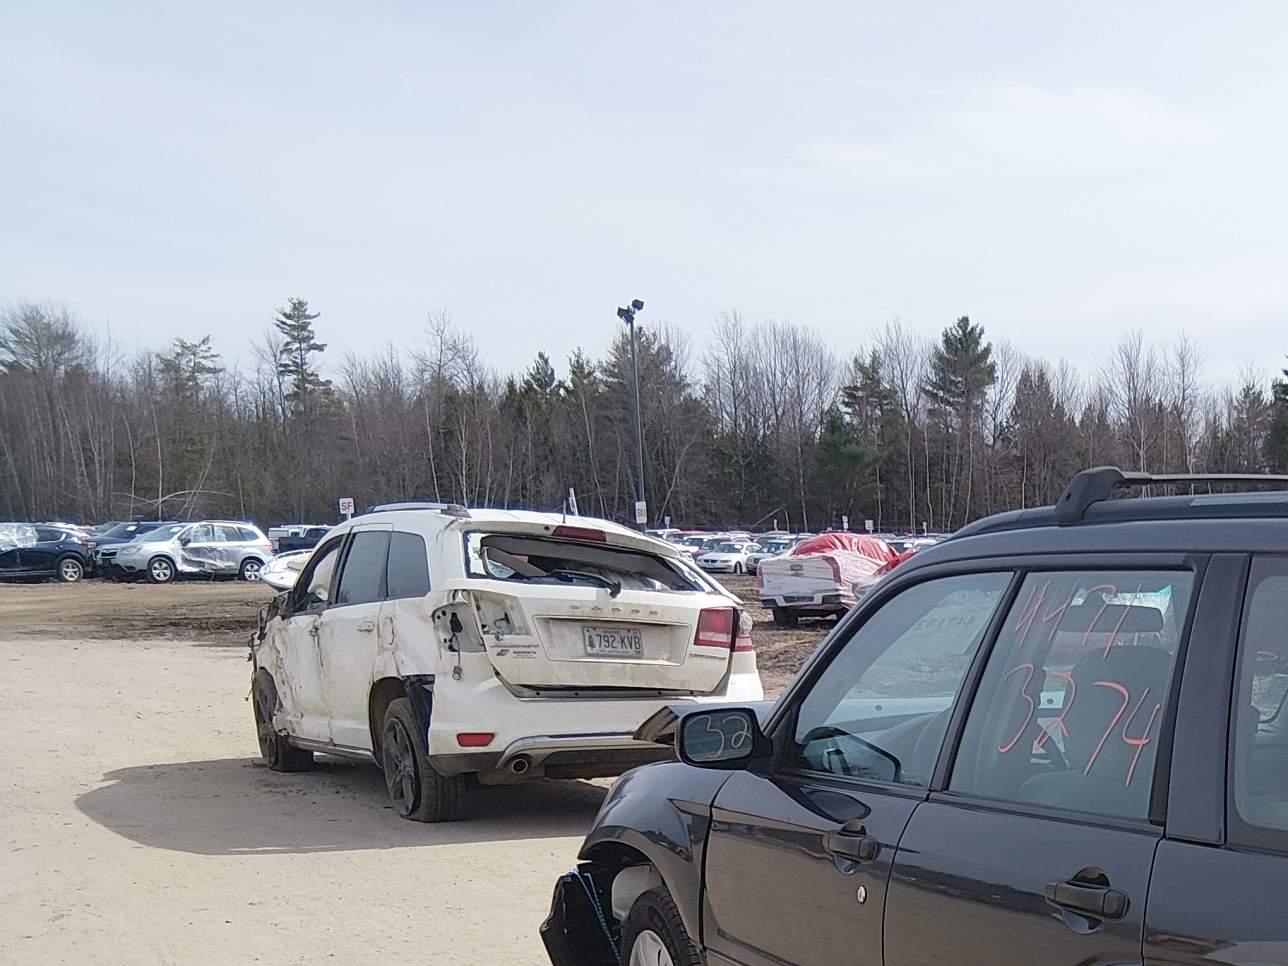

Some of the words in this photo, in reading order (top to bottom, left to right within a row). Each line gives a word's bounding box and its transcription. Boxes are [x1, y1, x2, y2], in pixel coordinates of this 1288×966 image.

[341, 501, 353, 511] SF
[686, 714, 752, 757] 32
[998, 663, 1161, 787] 3274
